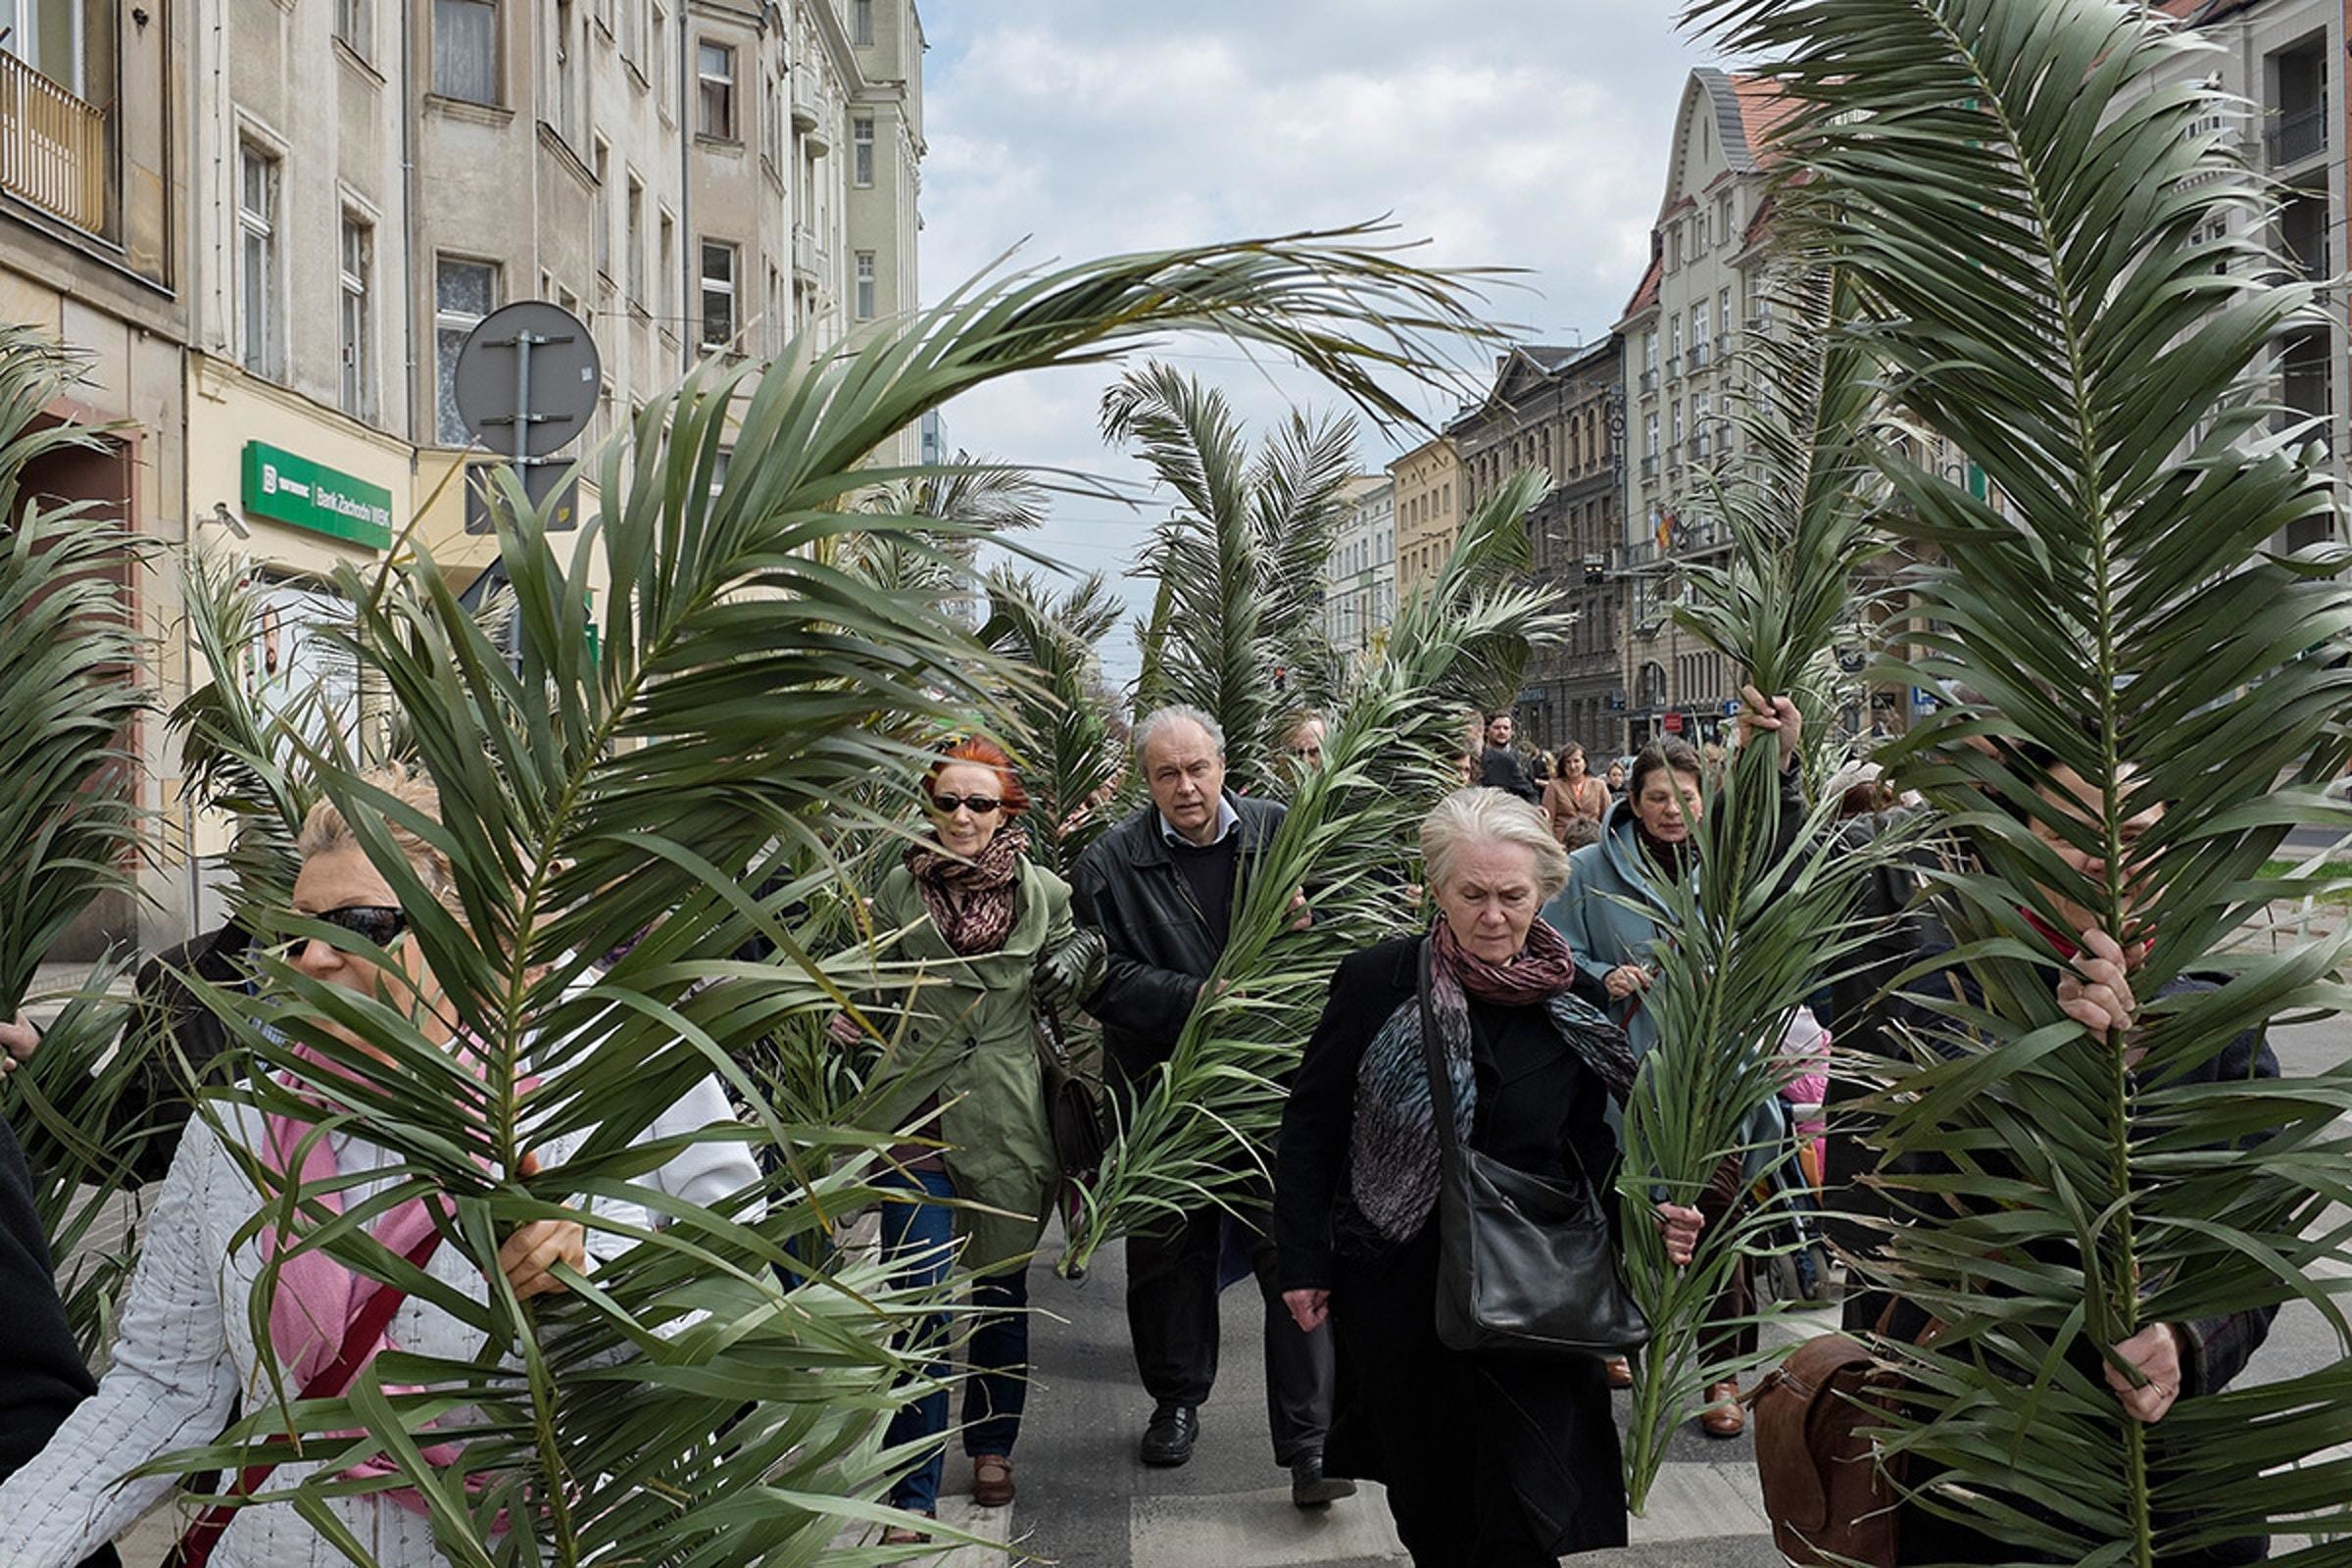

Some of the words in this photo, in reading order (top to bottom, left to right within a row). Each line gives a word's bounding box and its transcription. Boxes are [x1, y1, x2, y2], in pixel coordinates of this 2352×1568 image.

[1610, 394, 1625, 486] HOTEL
[317, 486, 337, 512] Bank
[370, 504, 391, 527] WBK
